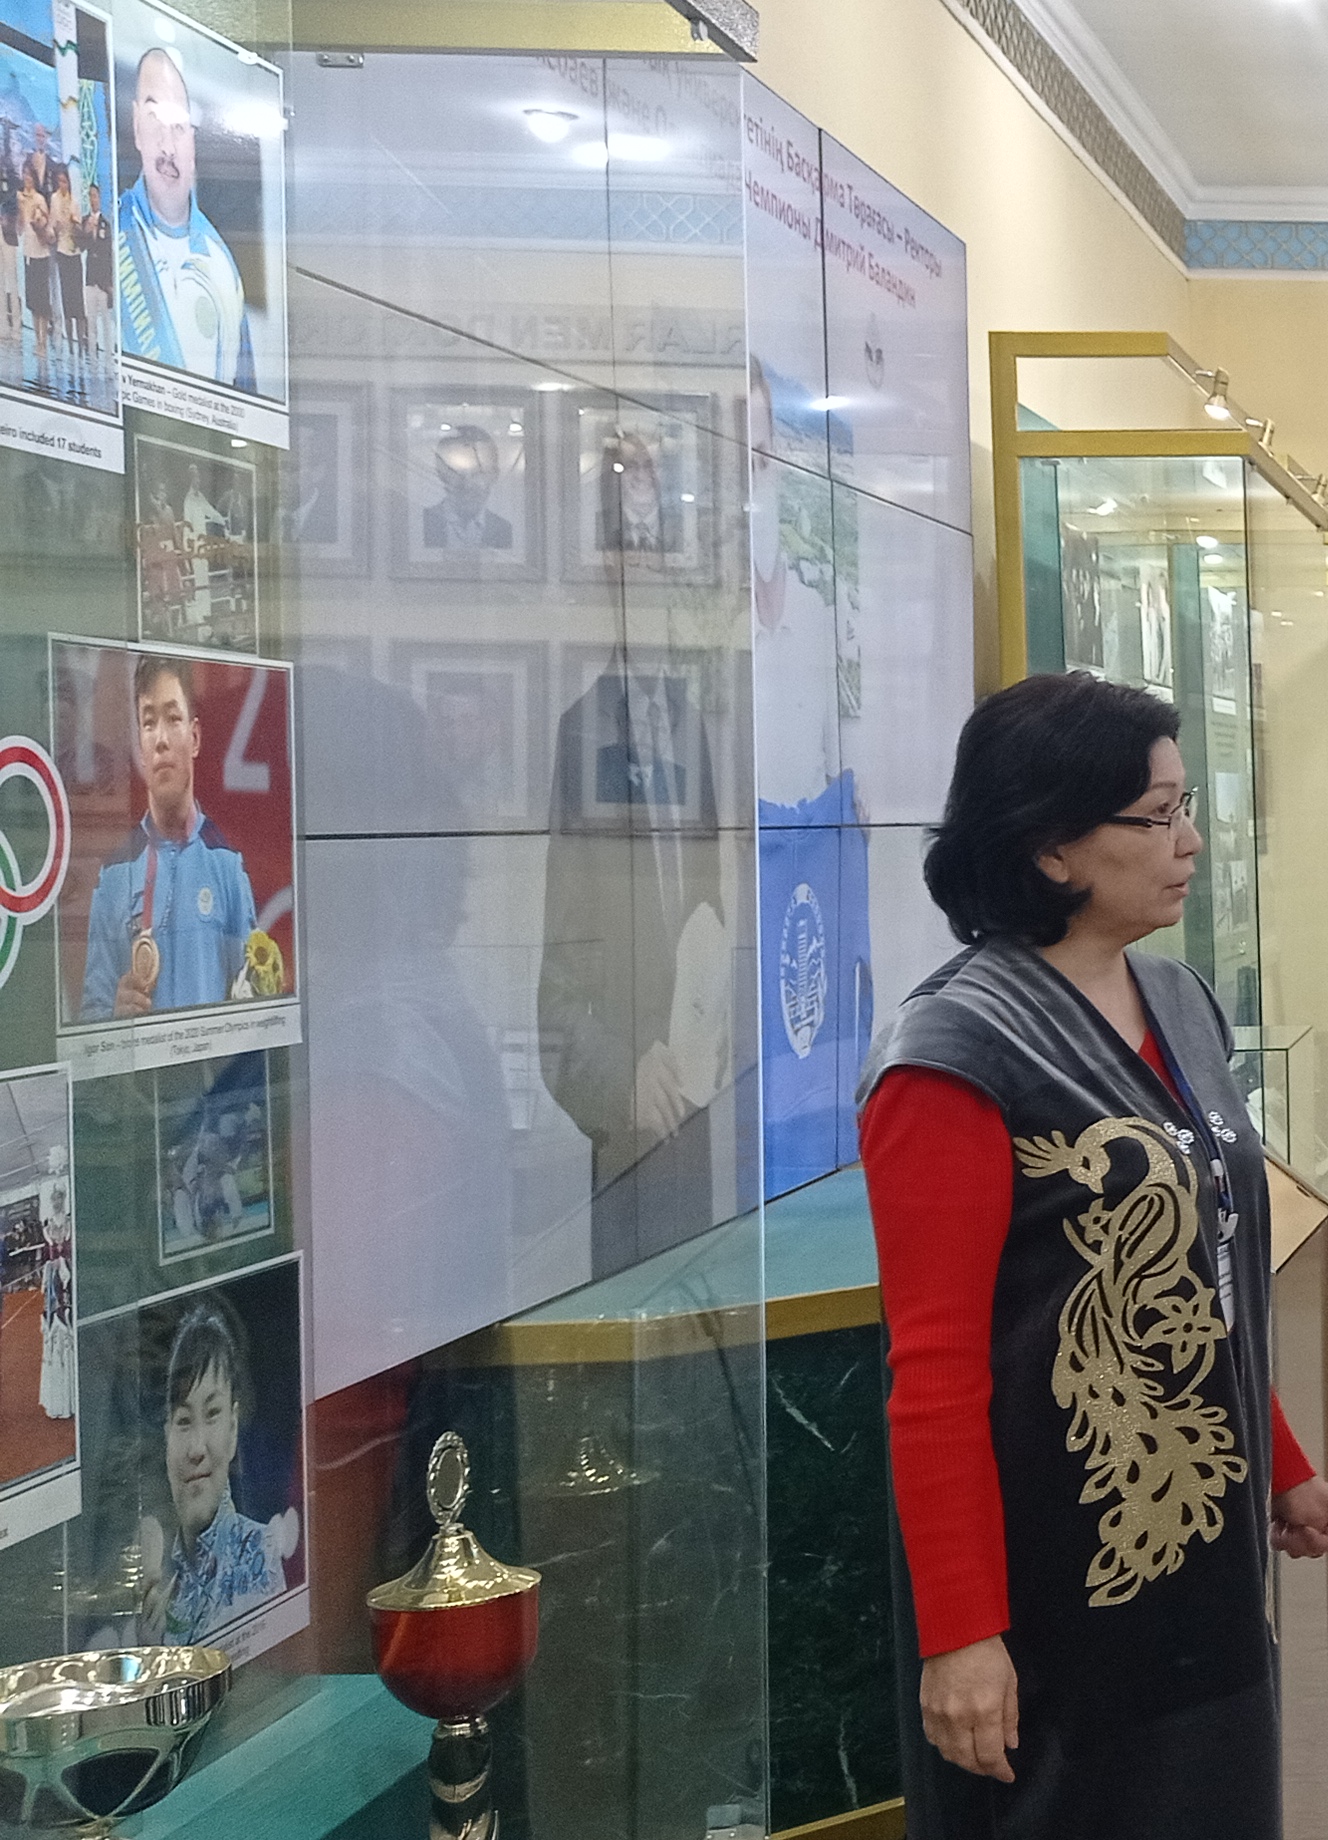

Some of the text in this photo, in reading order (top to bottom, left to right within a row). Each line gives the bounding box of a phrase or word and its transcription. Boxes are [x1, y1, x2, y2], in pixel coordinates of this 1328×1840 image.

[19, 426, 55, 448] included
[56, 436, 67, 450] 17
[68, 440, 102, 459] students
